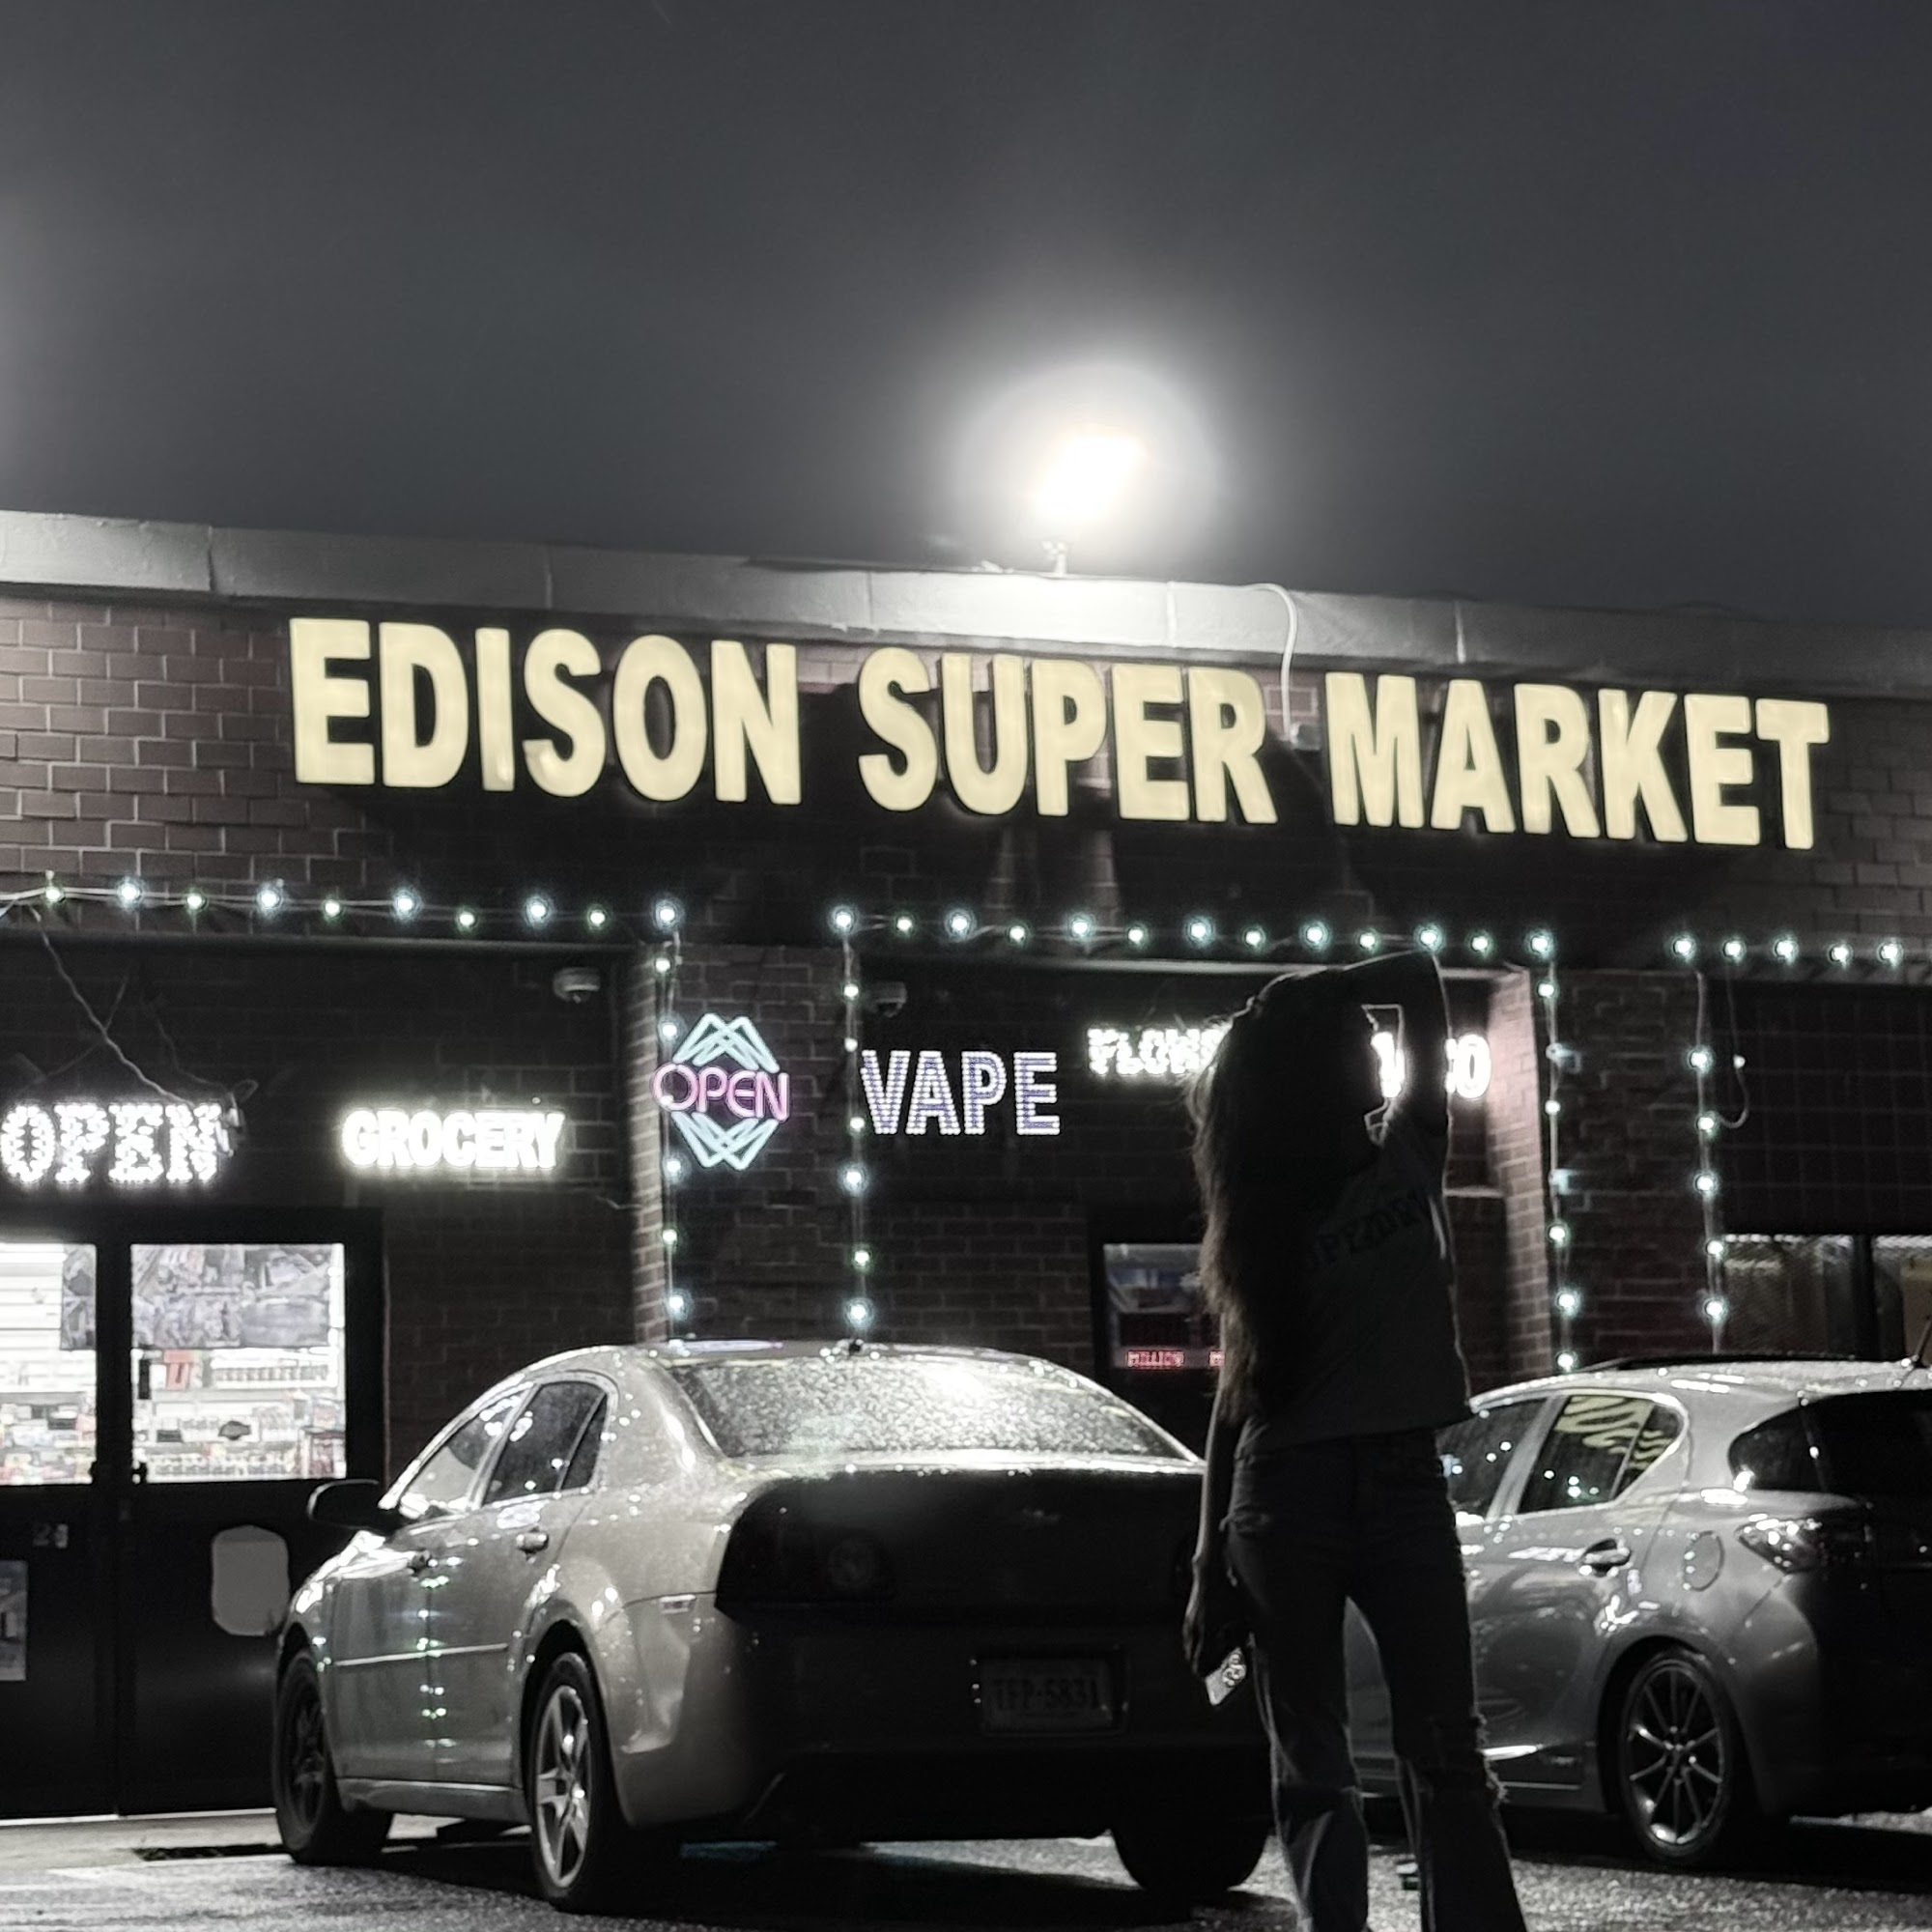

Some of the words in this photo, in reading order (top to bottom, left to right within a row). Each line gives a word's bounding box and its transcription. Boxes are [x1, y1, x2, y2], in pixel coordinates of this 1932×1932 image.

[289, 617, 801, 805] EDISON
[859, 647, 1278, 824] SUPER
[1325, 672, 1830, 849] MARKET
[653, 1064, 790, 1122] OPEN
[860, 1050, 1061, 1135] VAPE
[1, 1103, 222, 1182] OPEN
[341, 1109, 565, 1169] GROCERY
